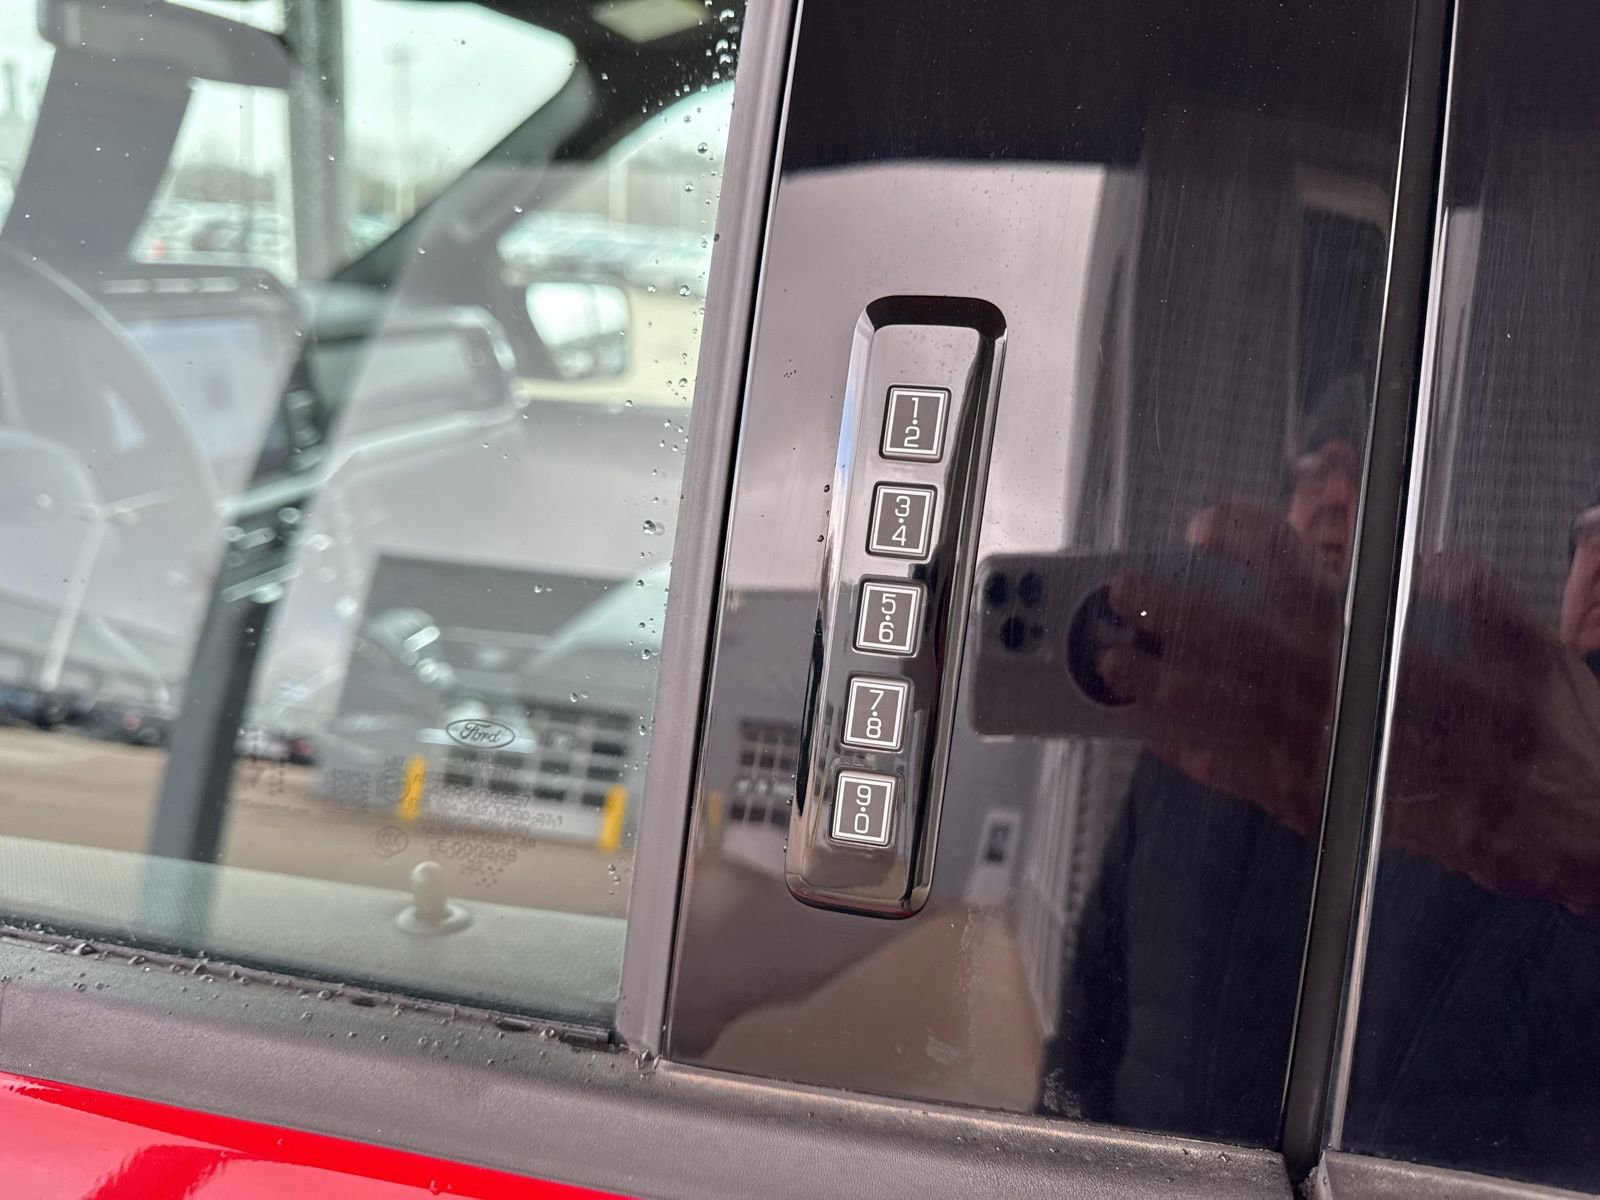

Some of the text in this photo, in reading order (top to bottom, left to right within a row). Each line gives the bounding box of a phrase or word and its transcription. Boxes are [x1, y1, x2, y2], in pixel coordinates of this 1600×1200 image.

[912, 397, 920, 419] 1
[903, 426, 921, 448] 2
[894, 495, 911, 517] 3
[891, 525, 907, 547] 4
[881, 593, 897, 615] 5
[877, 621, 895, 643] 6
[868, 689, 885, 711] 7
[459, 721, 502, 743] Ford
[865, 717, 882, 739] 8
[855, 784, 872, 807] 9
